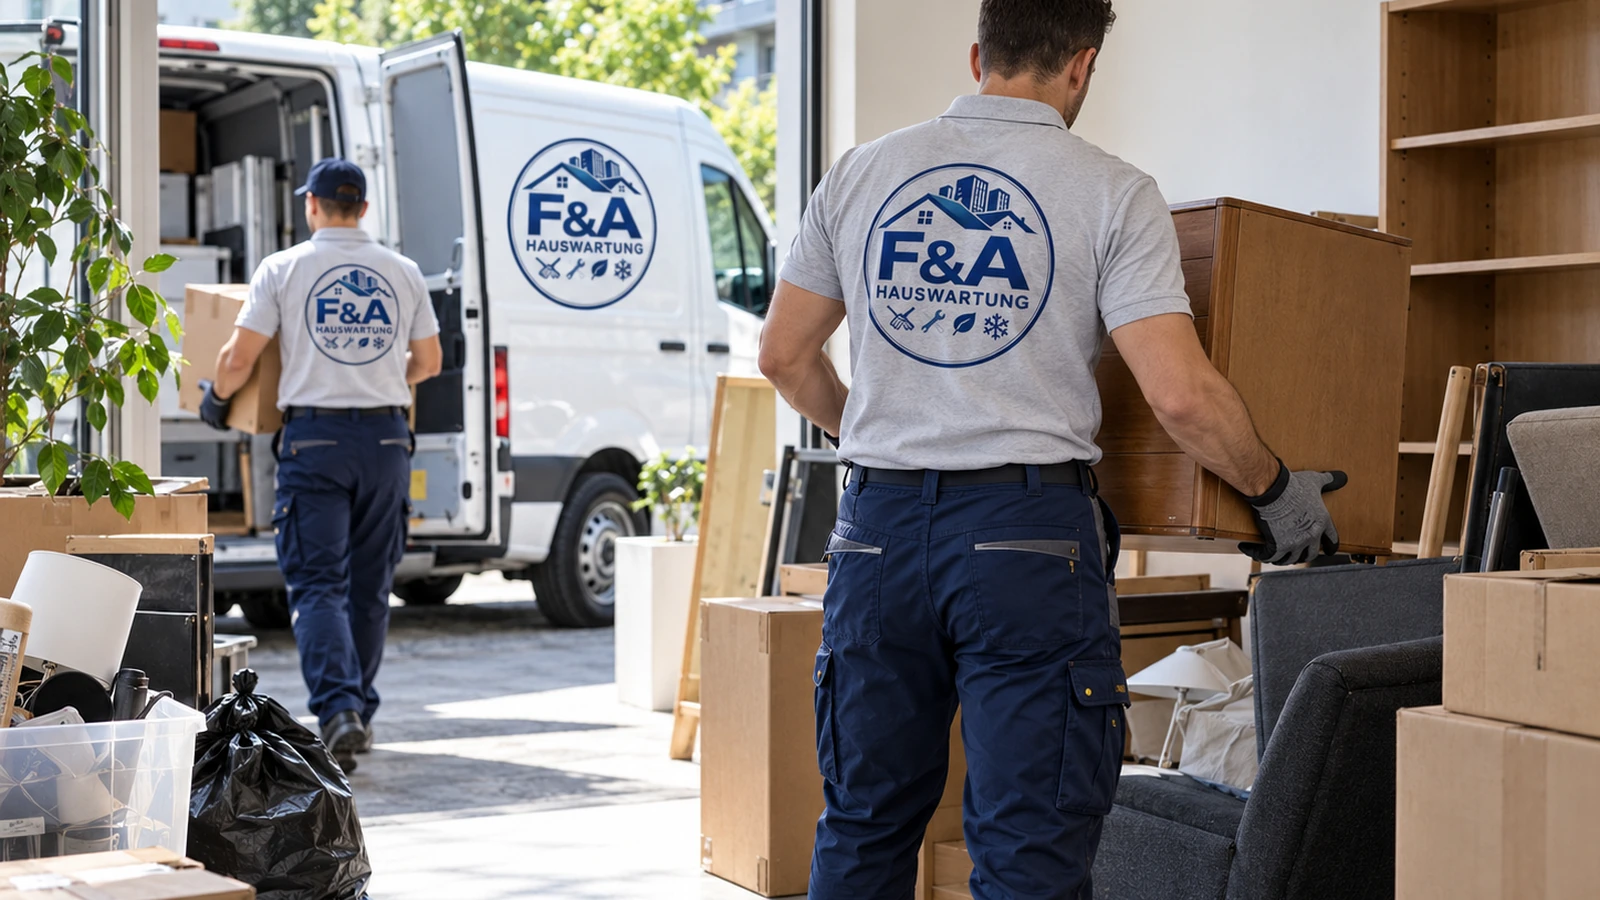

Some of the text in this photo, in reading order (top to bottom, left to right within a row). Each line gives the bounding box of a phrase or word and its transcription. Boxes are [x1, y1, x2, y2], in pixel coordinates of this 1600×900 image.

[528, 192, 642, 239] F&A
[526, 239, 643, 255] HAUSWARTUNG
[878, 231, 1030, 291] F&A
[876, 285, 1029, 309] HAUSWARTUNG
[316, 298, 392, 325] F&A
[315, 326, 393, 335] HAUSWARTUNG
